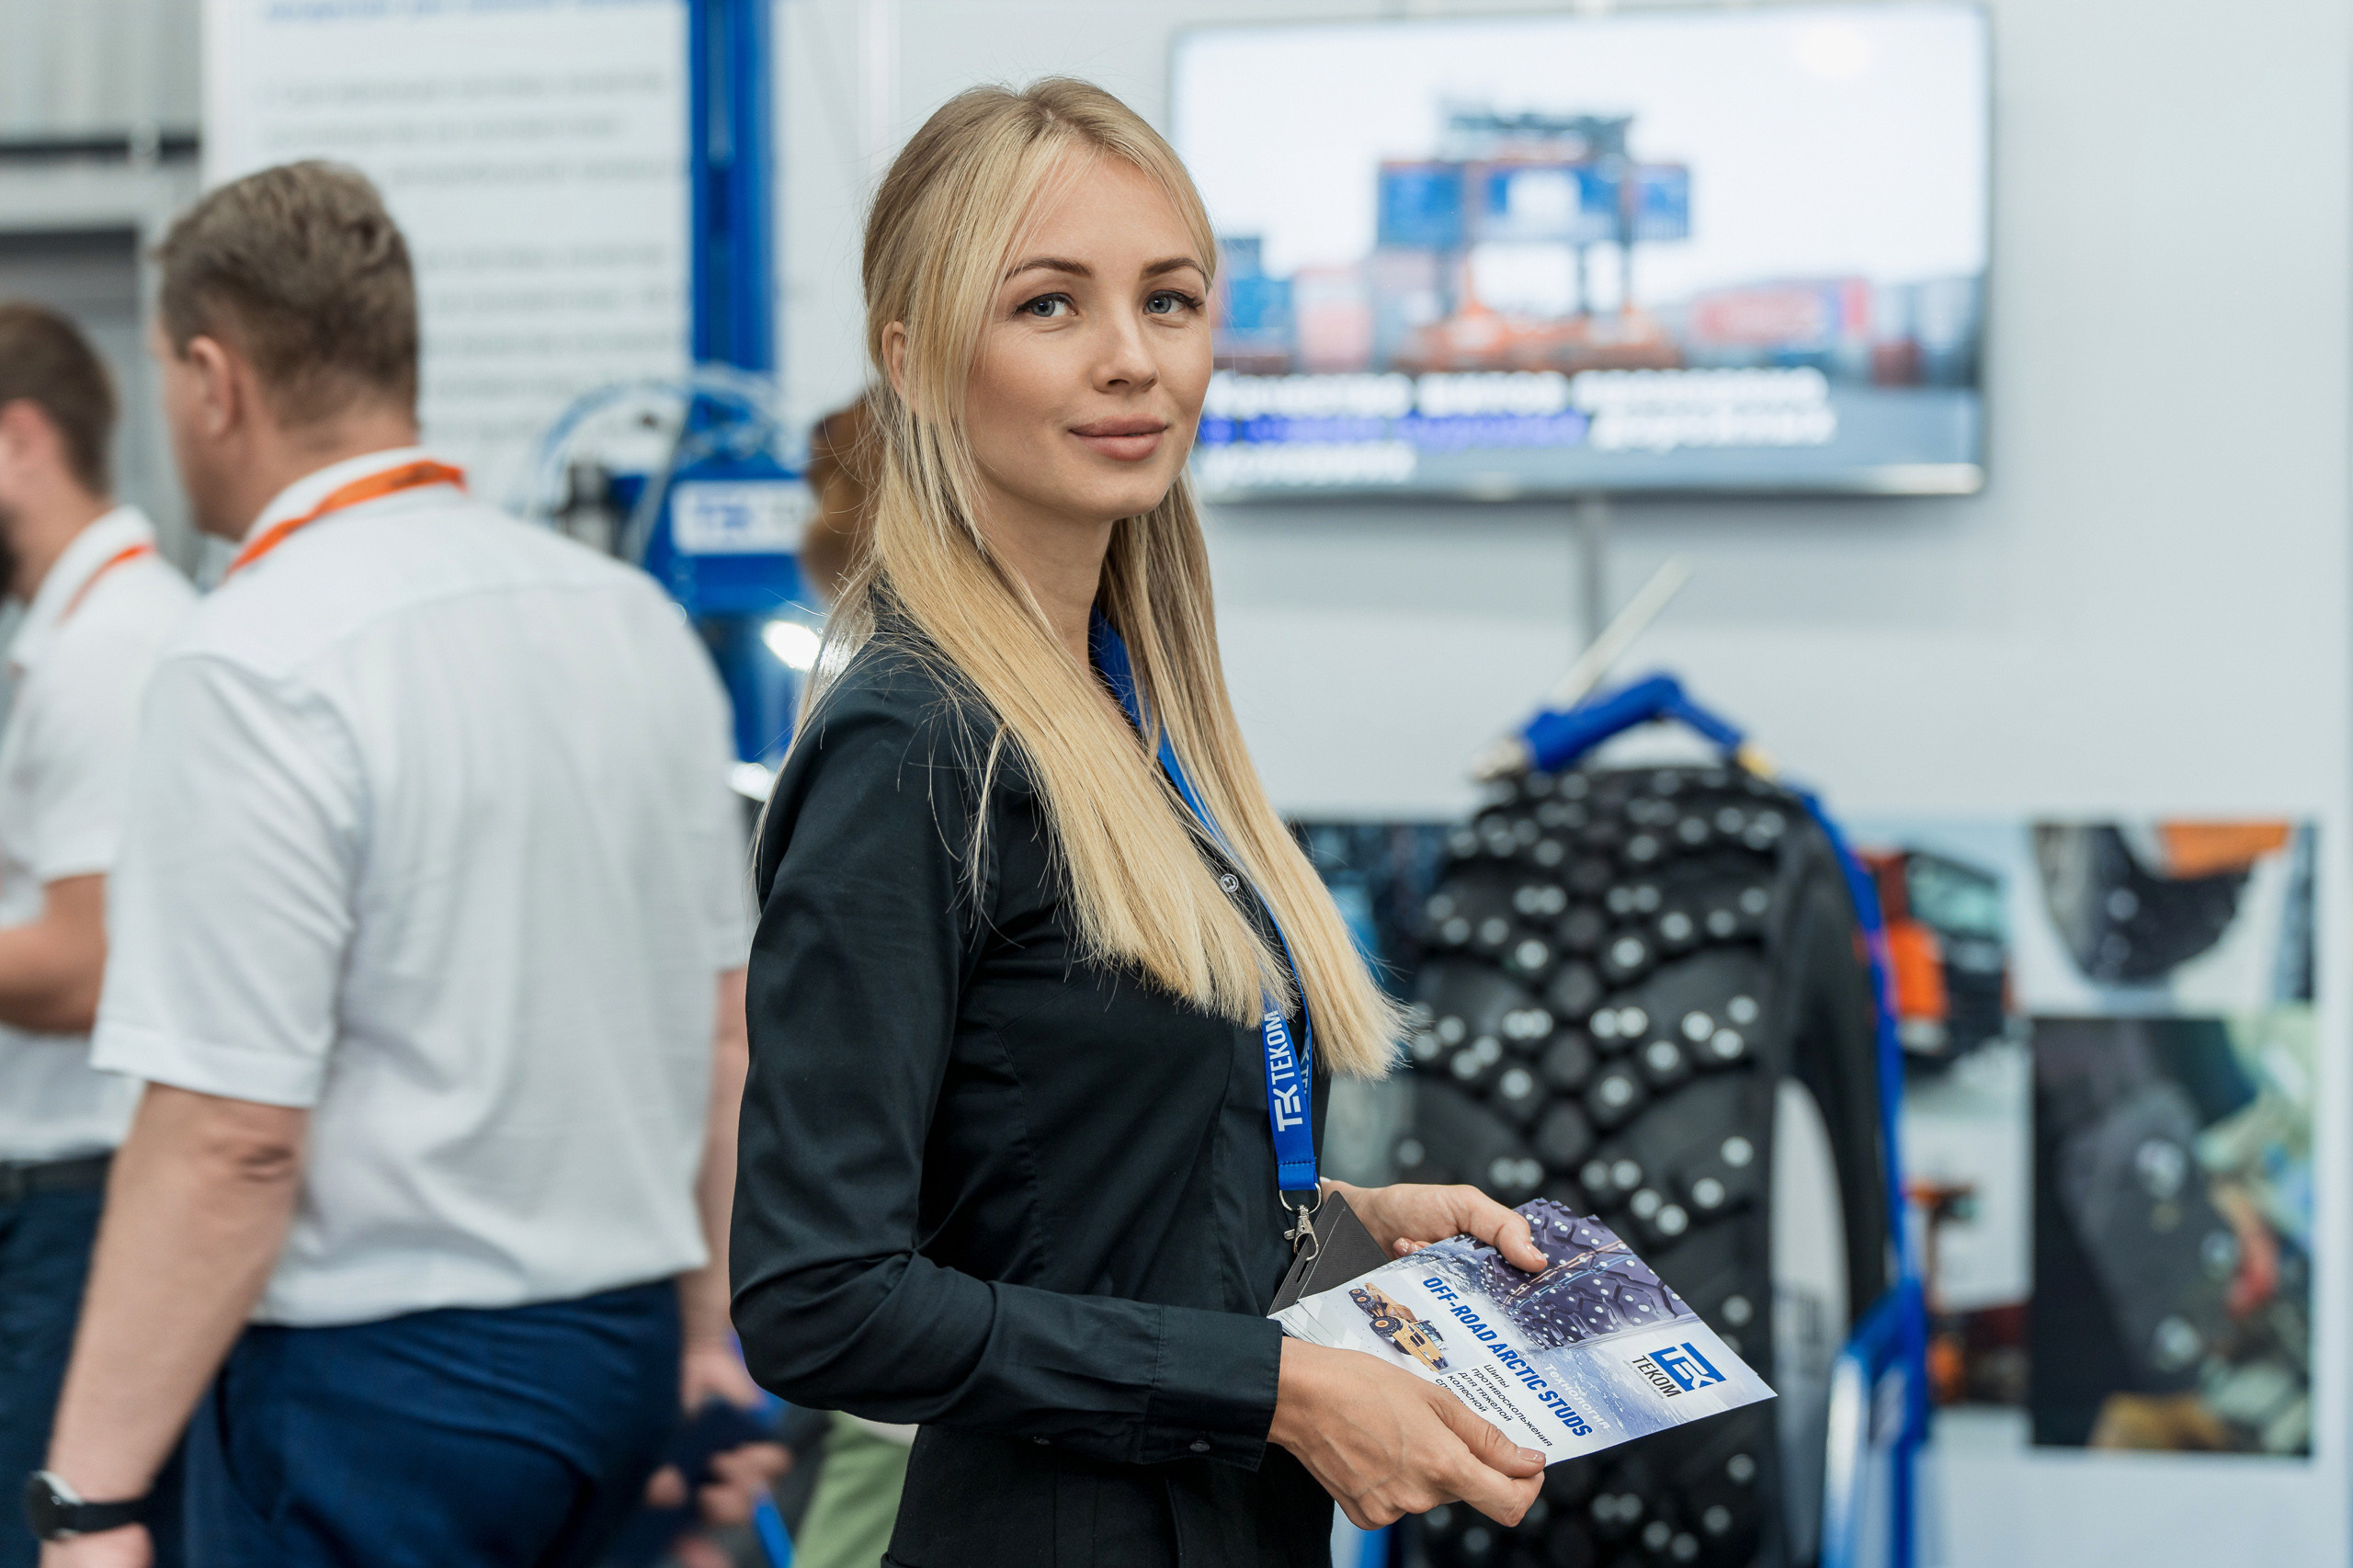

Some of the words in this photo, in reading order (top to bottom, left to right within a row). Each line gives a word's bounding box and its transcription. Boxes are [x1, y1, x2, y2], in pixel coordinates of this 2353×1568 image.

[1264, 1010, 1295, 1085] TEKOM
[1423, 1277, 1498, 1342] OFF-ROAD
[1487, 1343, 1548, 1391] ARCTIC
[1538, 1390, 1593, 1437] STUDS
[1483, 1364, 1510, 1389] Шипы
[1631, 1355, 1683, 1398] TEKOM
[1447, 1375, 1490, 1413] колесной
[1458, 1371, 1478, 1388] для
[1476, 1387, 1514, 1422] тяжелой
[1472, 1368, 1553, 1447] противоскольжения
[1544, 1363, 1611, 1429] Технология
